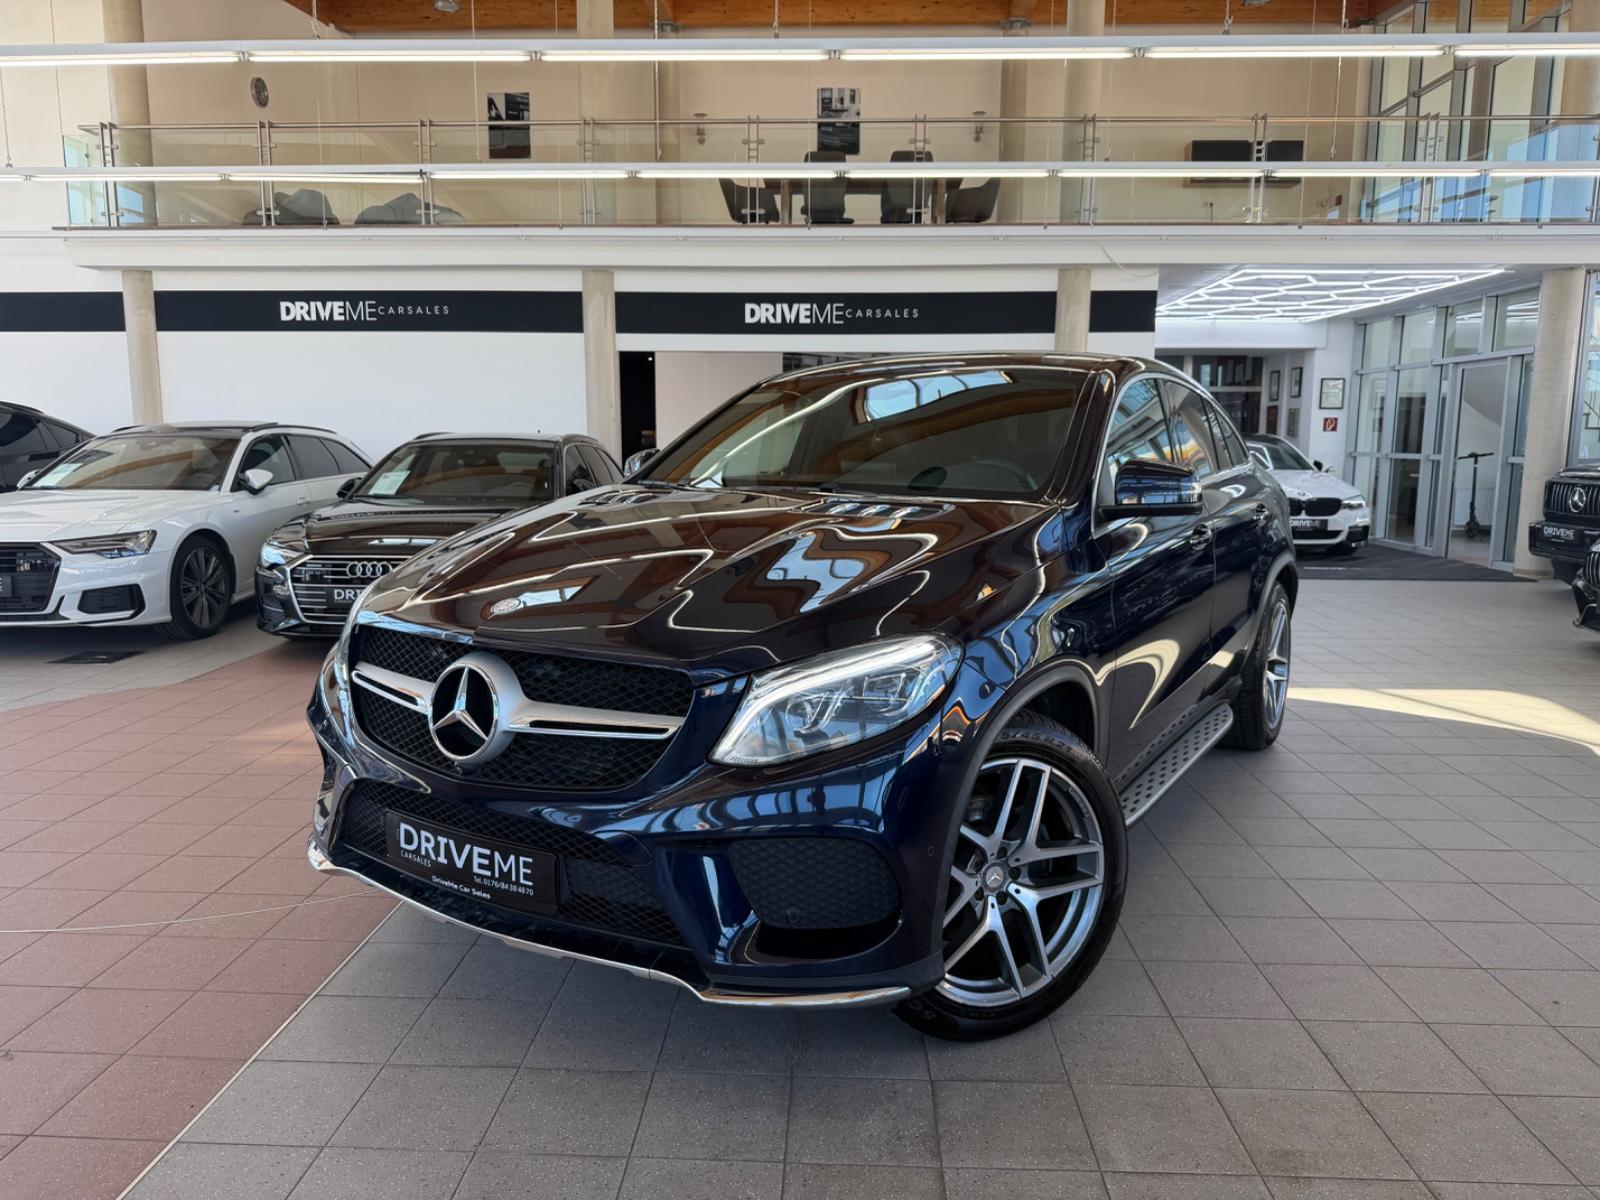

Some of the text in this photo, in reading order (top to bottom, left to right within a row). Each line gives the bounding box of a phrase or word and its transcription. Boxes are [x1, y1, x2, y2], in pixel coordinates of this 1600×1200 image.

[279, 300, 449, 322] DRIVEME CARSALES
[744, 303, 919, 324] DRIVEME CARSALES
[1543, 526, 1575, 538] DRIVEME
[400, 822, 533, 886] DRIVEME
[400, 850, 432, 868] CARSALES
[431, 875, 491, 899] DriveMe Car Sales
